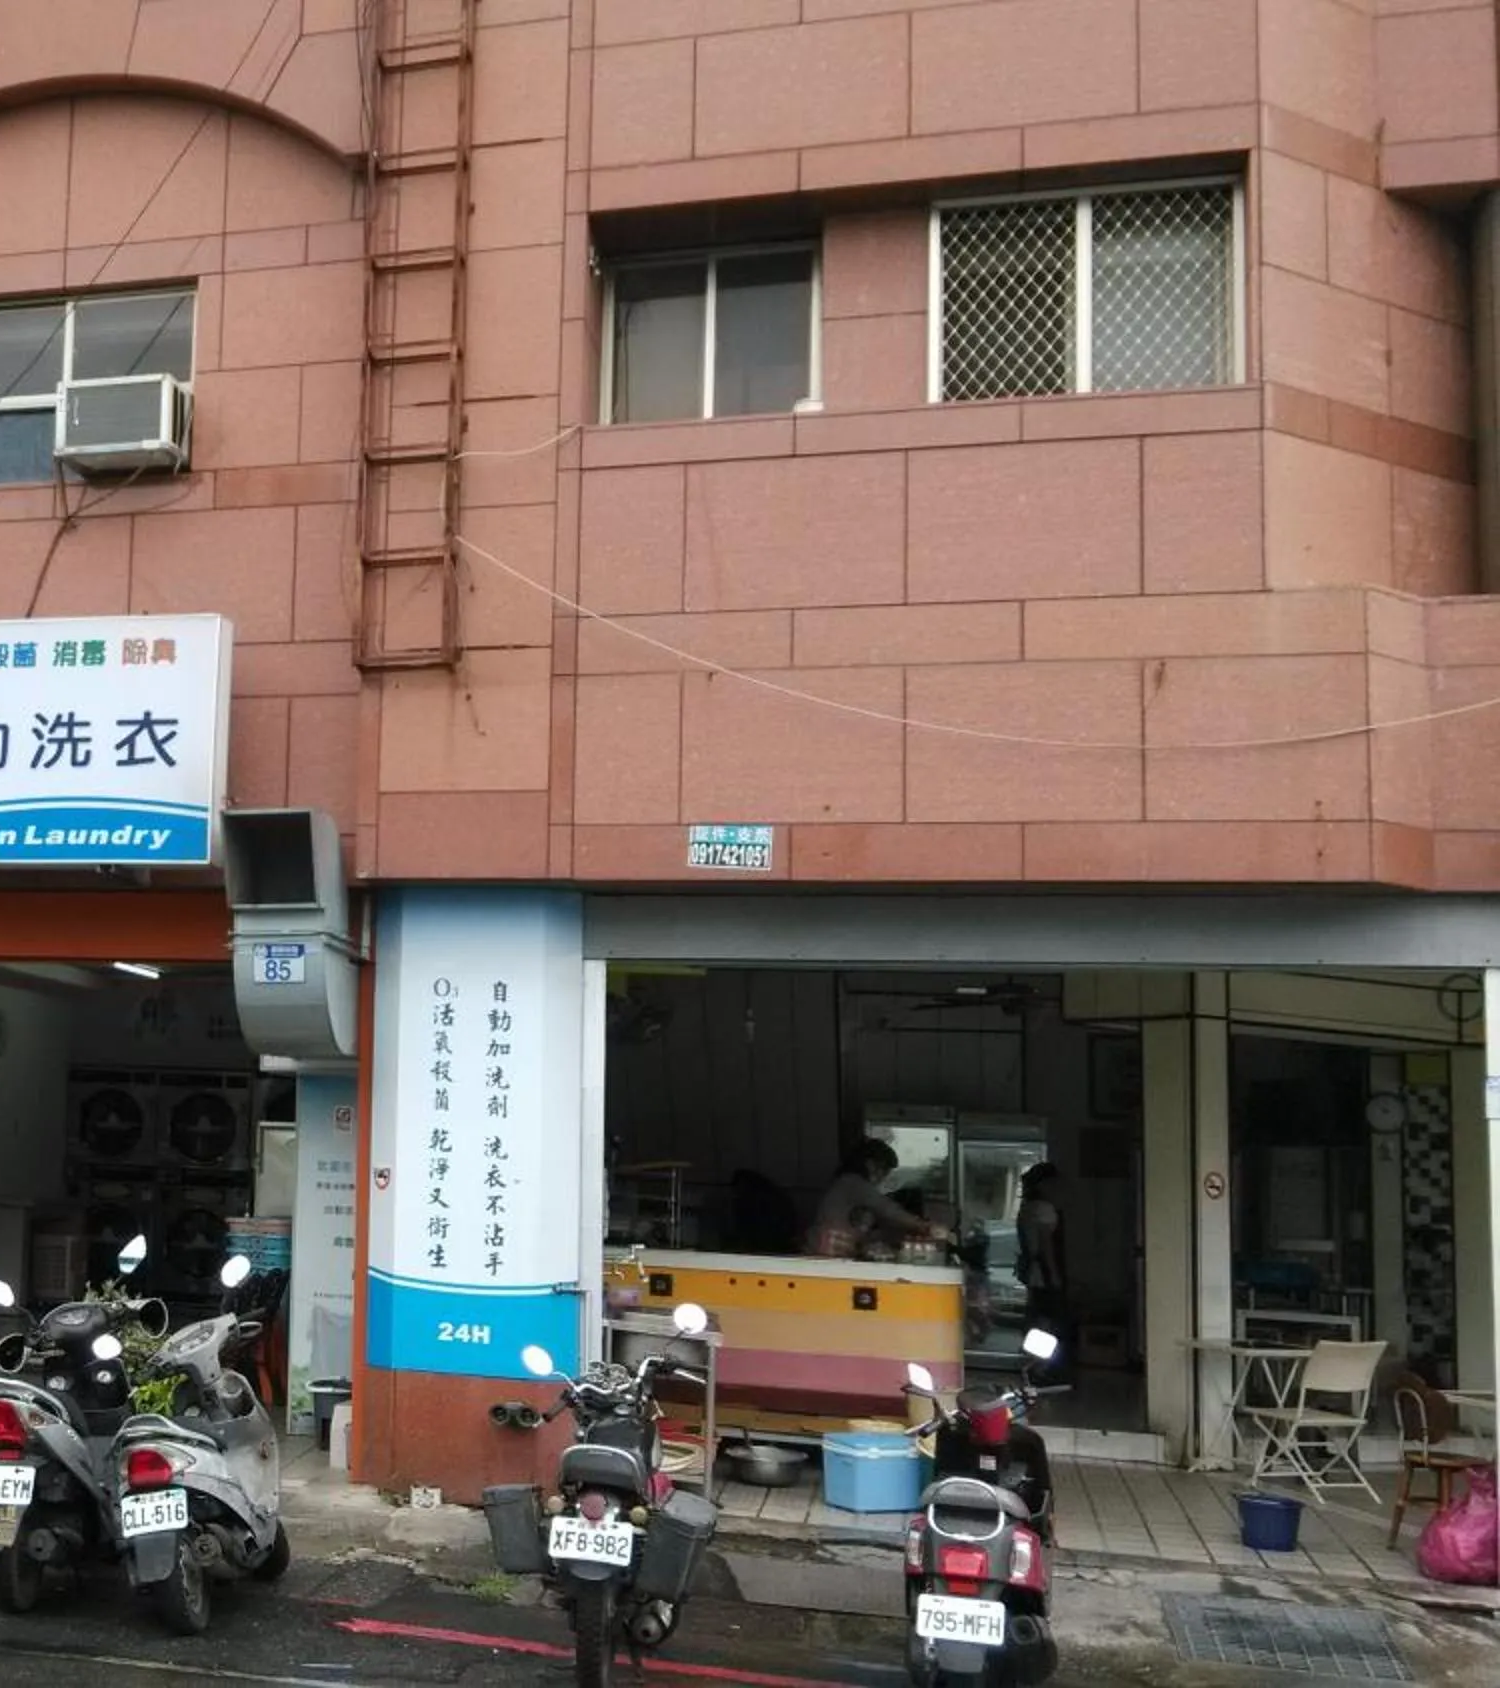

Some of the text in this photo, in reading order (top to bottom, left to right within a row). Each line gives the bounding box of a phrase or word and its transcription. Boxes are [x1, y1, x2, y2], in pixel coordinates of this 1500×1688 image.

[24, 824, 171, 851] Laundry
[265, 959, 291, 981] 85
[483, 980, 513, 1277] 自動加洗劑 洗衣不沾手
[436, 1322, 491, 1344] 24H
[123, 1503, 185, 1531] CLL-516
[920, 1608, 1001, 1639] 795-MFH
